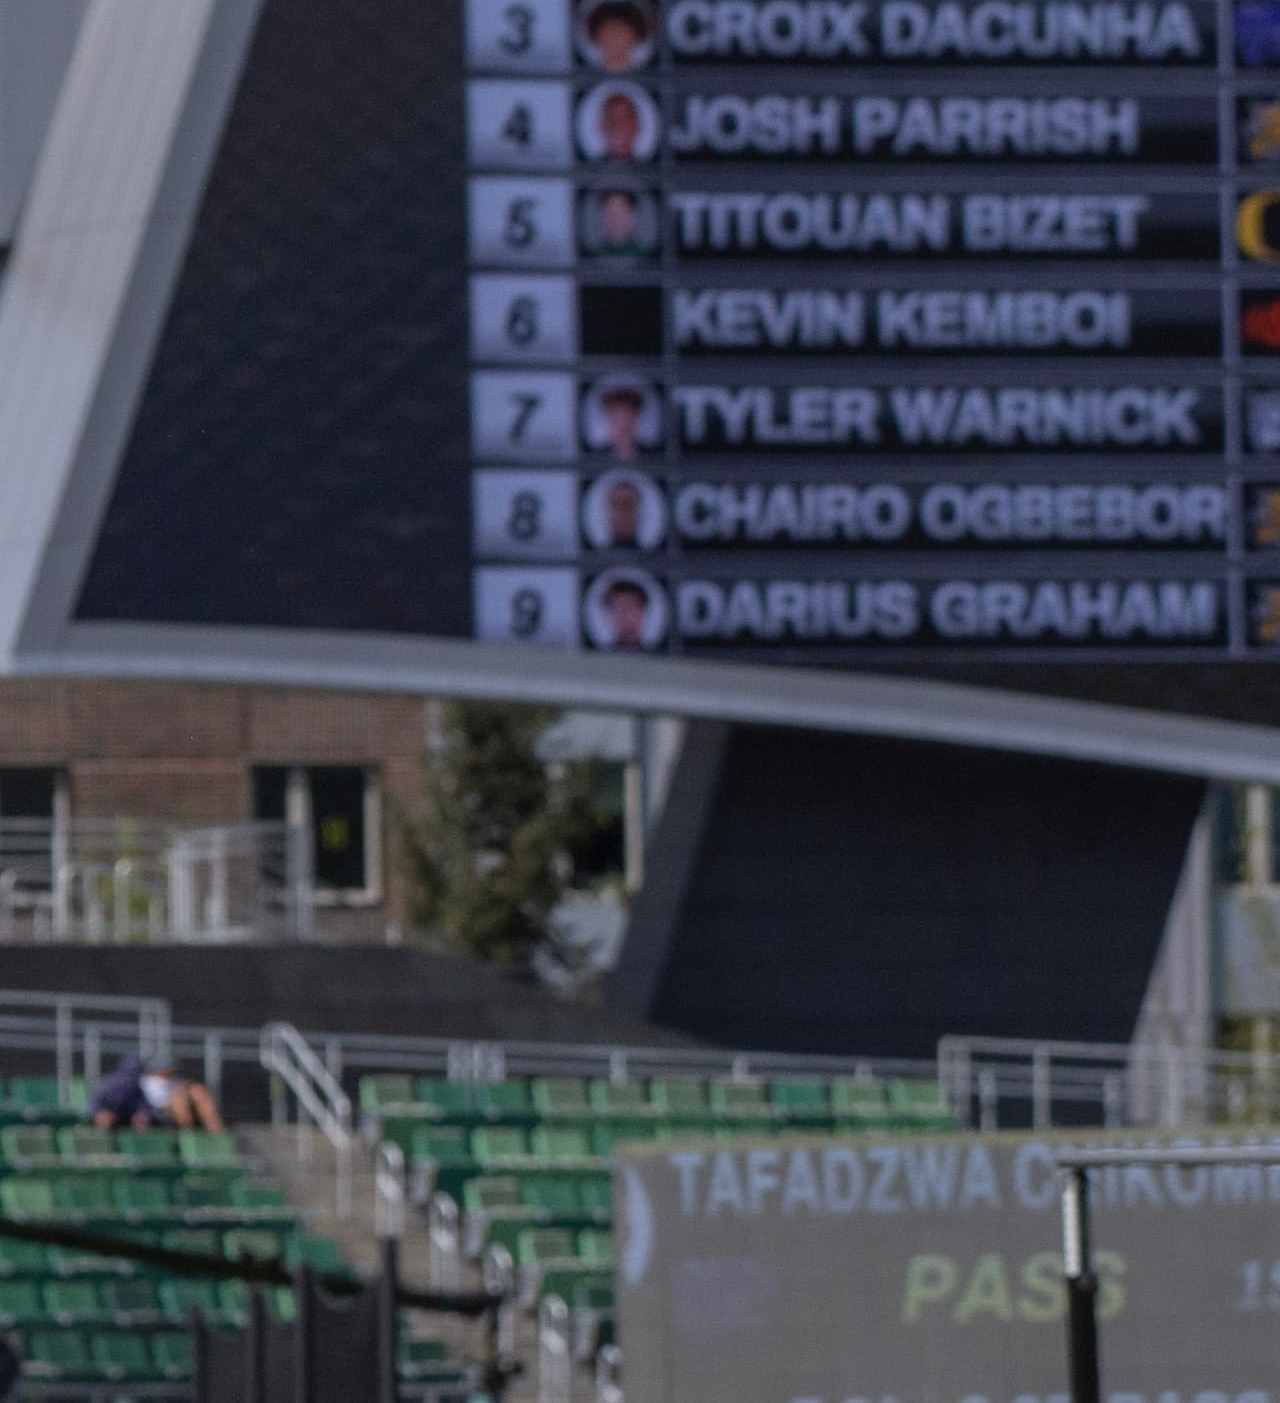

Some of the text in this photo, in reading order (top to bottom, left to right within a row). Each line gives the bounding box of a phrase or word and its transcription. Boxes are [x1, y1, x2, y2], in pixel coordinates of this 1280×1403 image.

[499, 0, 1201, 59] 3 CROIX DACUNHA
[502, 97, 1139, 156] 4 JOSH PARRISH
[504, 193, 1152, 251] 5 TITOUAN BIZET
[506, 289, 1132, 349] 6 KEVIN KEMBOI
[508, 386, 1202, 446] 7 TYLER WARNICK
[508, 481, 1228, 542] 8 CHAIRO OGBEBOR
[510, 579, 1219, 639] 9 DARIUS GRAHAM
[669, 1144, 1002, 1216] TAFADZWA
[899, 1247, 1129, 1326] PASS
